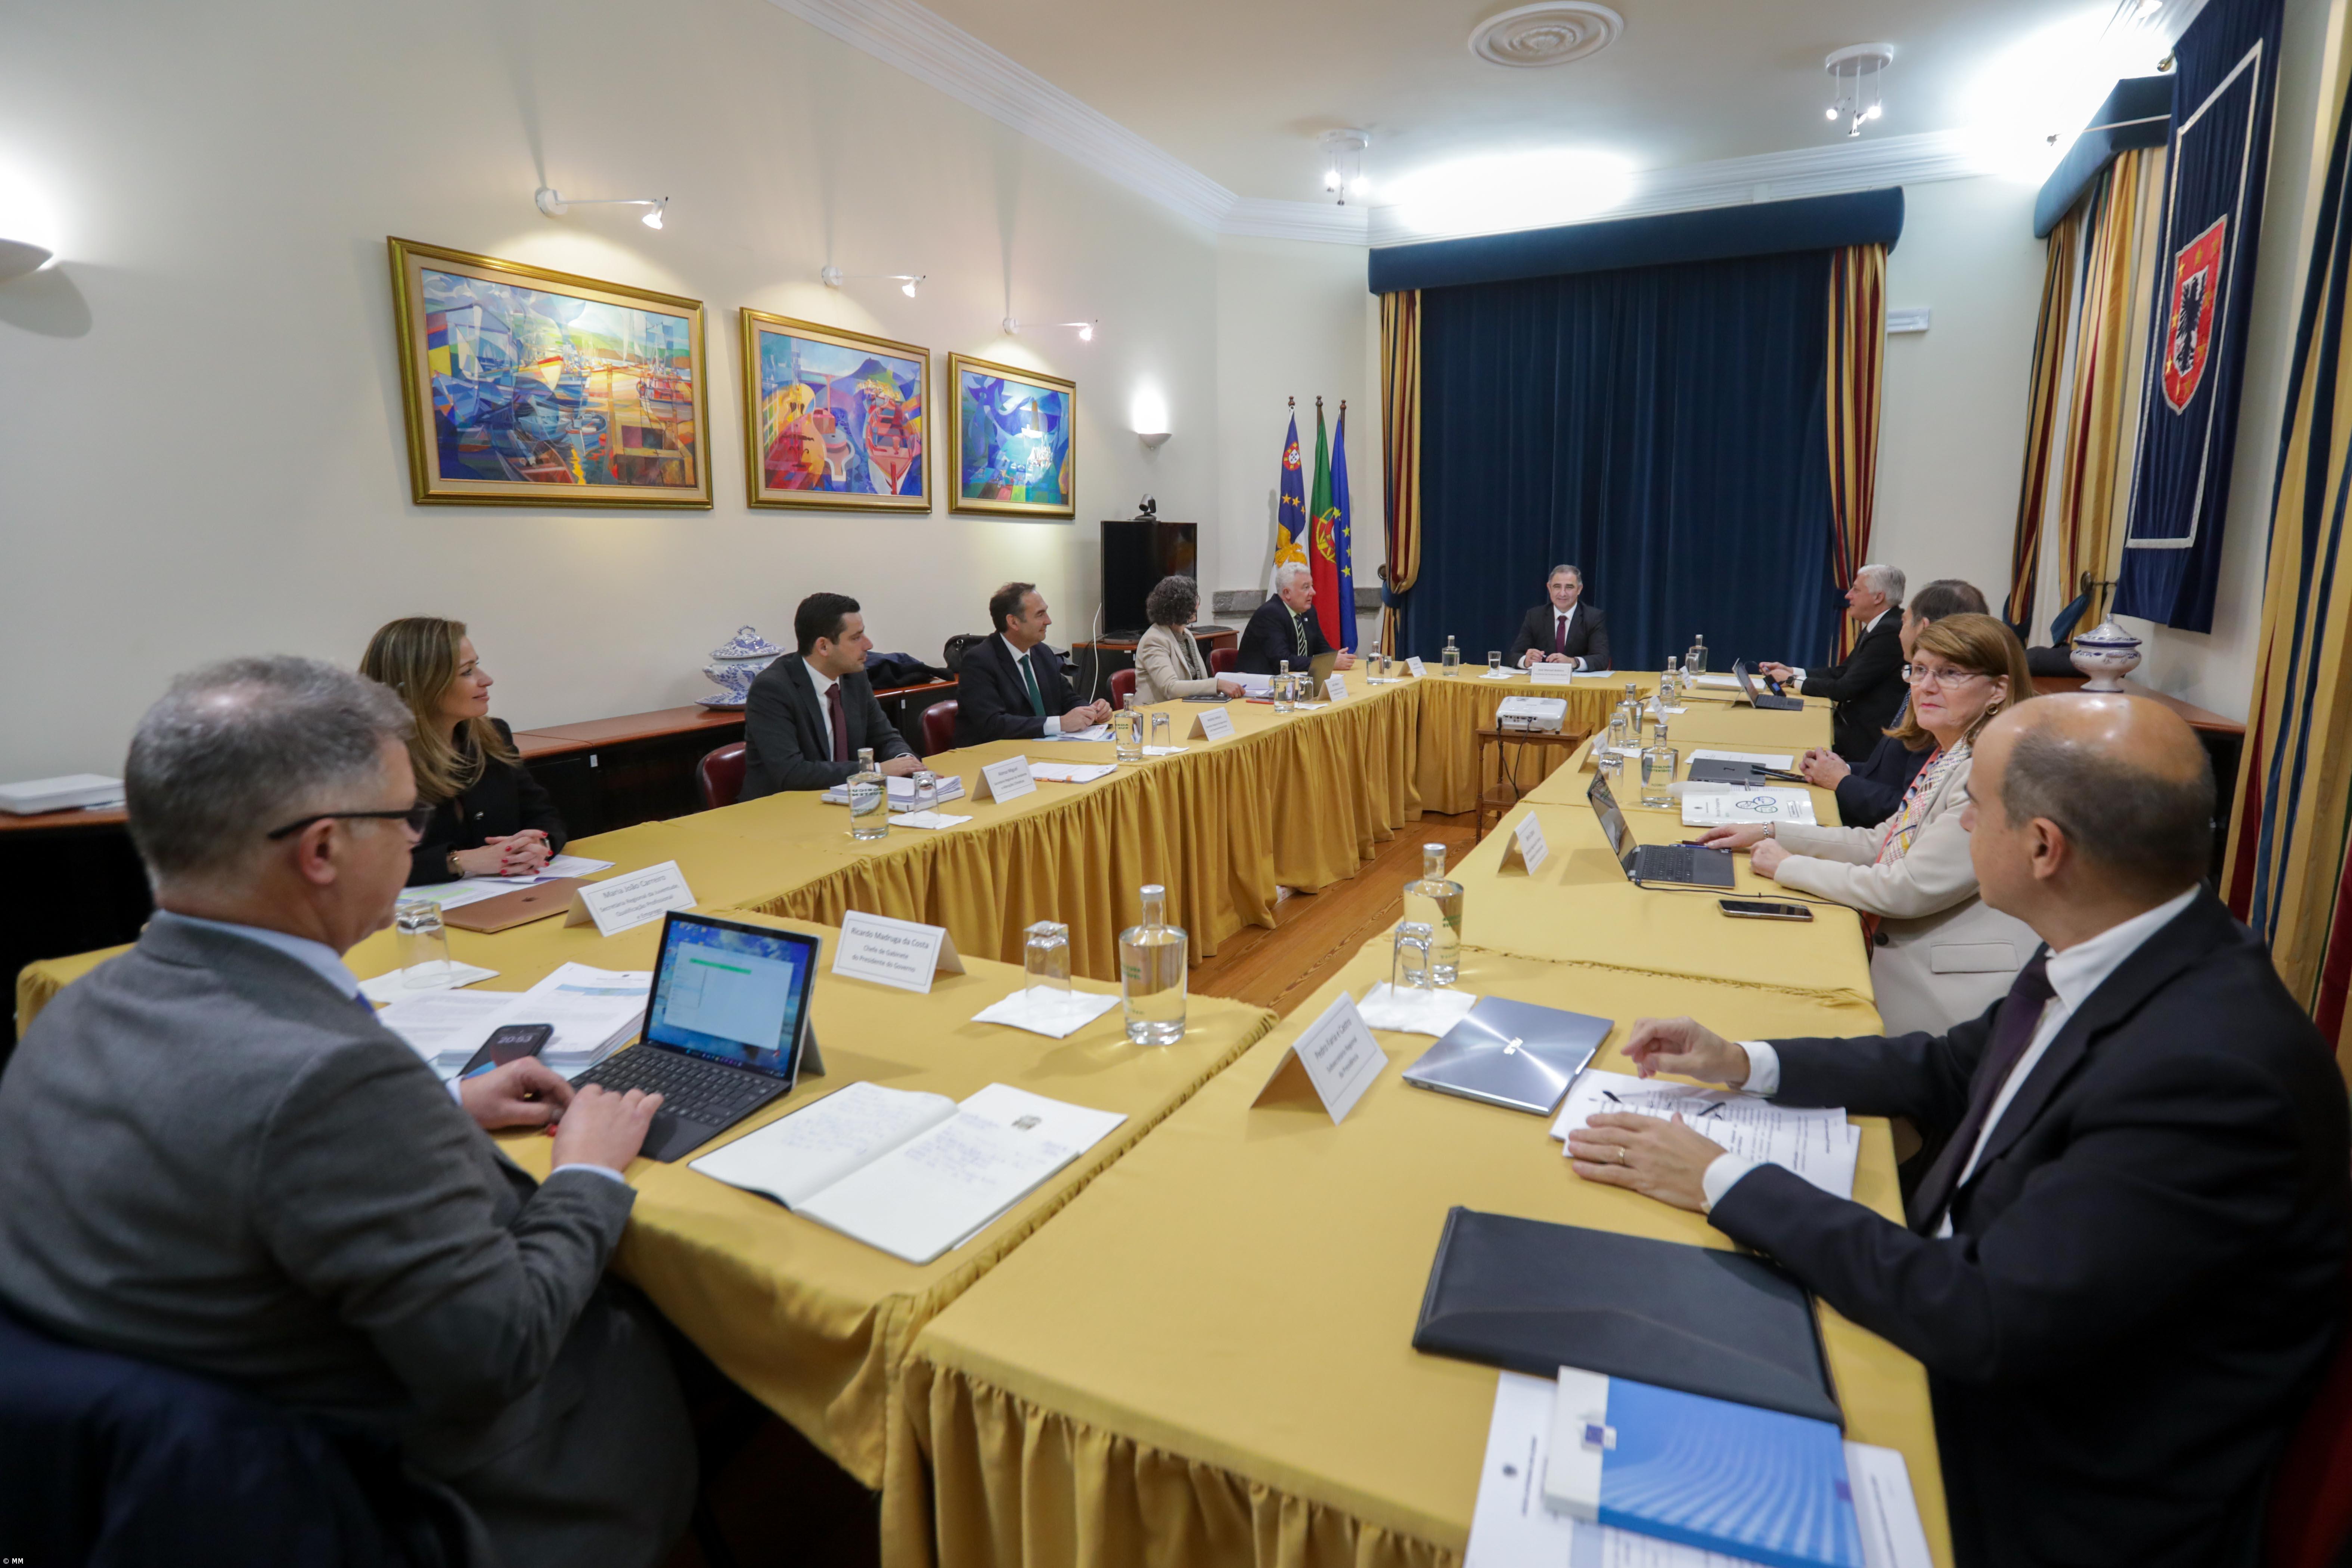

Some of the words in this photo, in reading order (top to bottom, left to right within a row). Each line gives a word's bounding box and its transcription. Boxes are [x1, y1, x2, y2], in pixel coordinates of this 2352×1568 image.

[603, 888, 624, 898] Maria
[625, 882, 640, 892] João
[640, 875, 667, 887] Carreiro
[851, 927, 873, 938] Ricardo
[874, 932, 901, 944] Madruga
[902, 937, 910, 946] da
[911, 939, 929, 949] Costa
[863, 945, 878, 953] Chefe
[885, 950, 909, 960] Gabinete
[859, 955, 885, 966] Presidente
[894, 962, 916, 973] Governo
